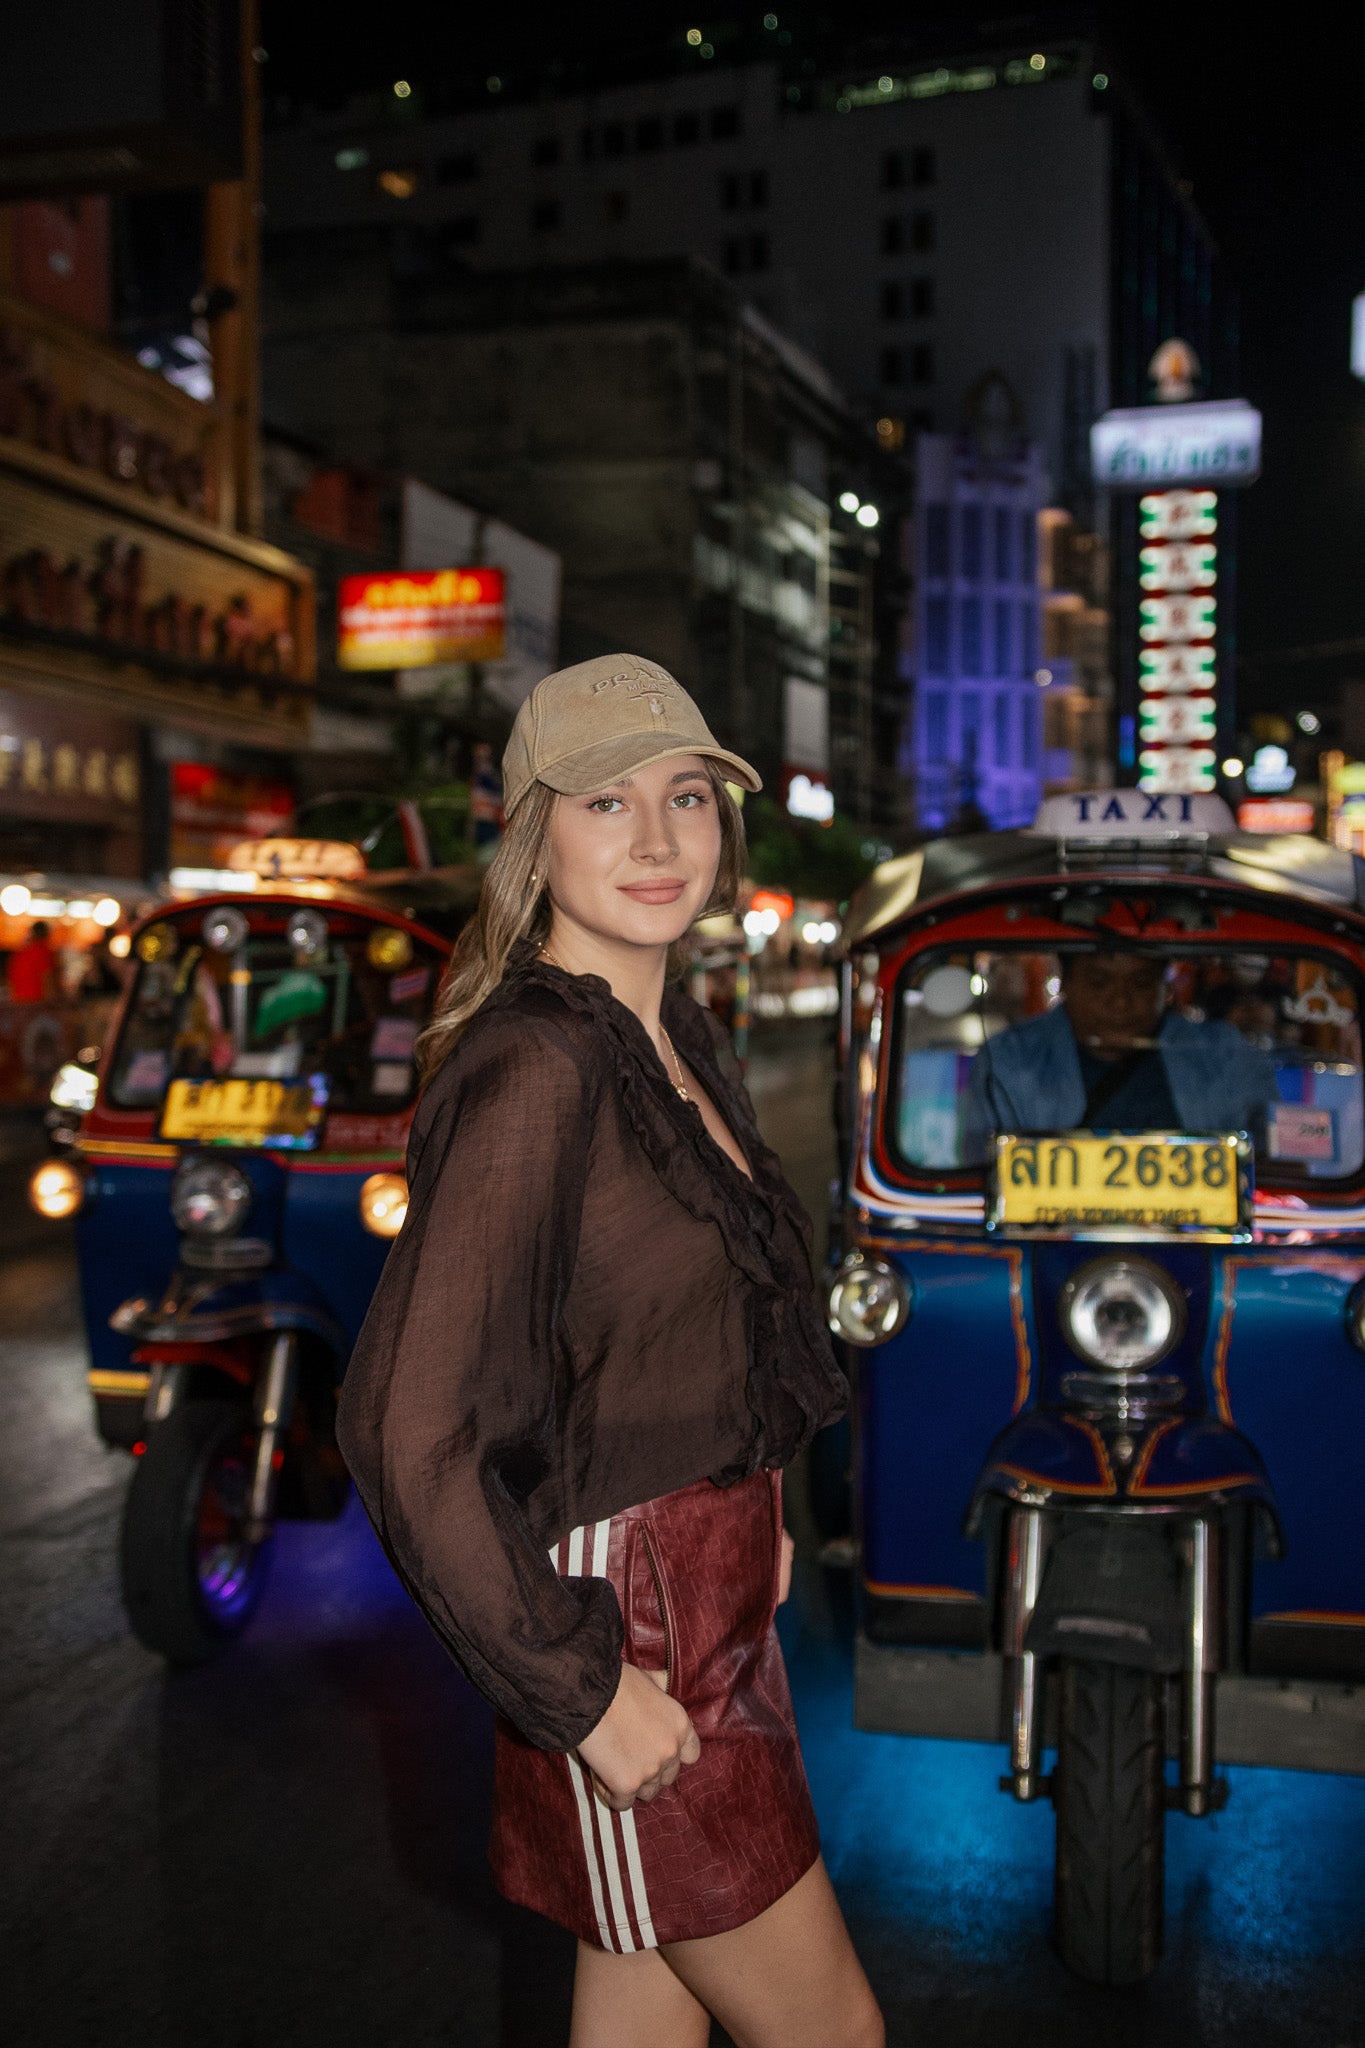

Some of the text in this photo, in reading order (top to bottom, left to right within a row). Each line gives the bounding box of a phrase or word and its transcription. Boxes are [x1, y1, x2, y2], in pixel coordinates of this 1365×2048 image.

[627, 682, 669, 692] MILANO
[1073, 794, 1194, 822] TAXI
[1103, 1144, 1229, 1188] 2638
